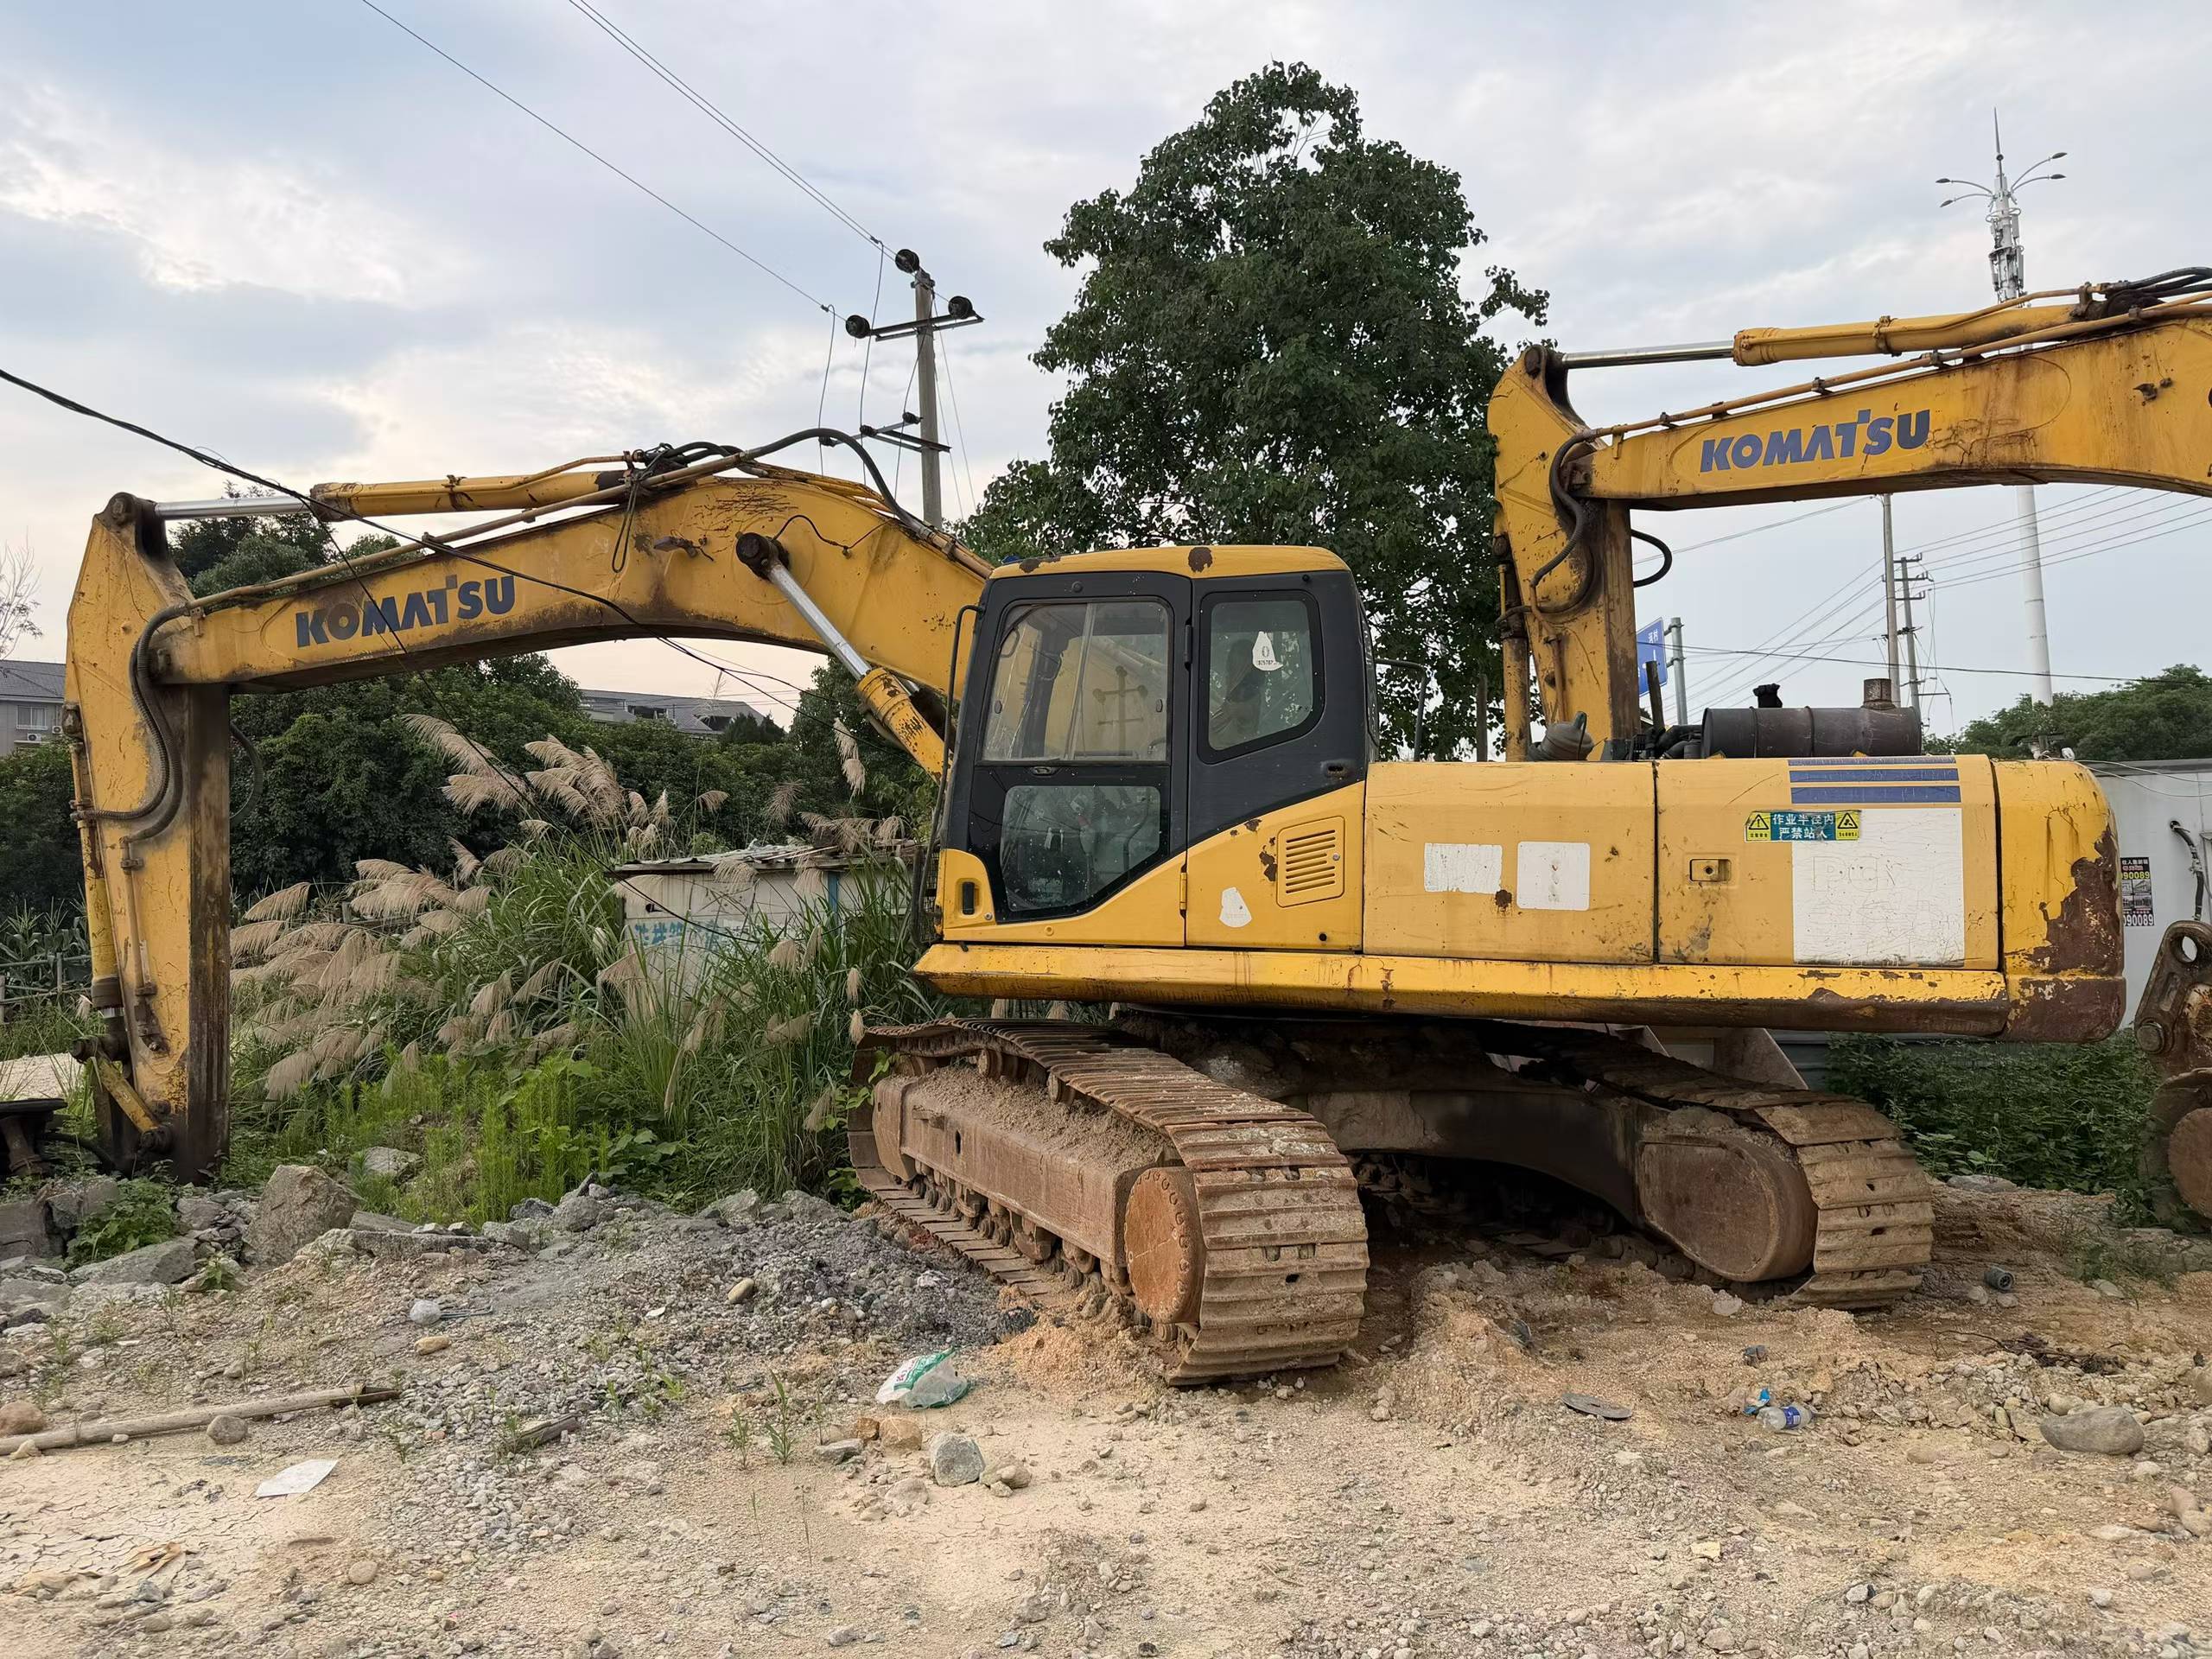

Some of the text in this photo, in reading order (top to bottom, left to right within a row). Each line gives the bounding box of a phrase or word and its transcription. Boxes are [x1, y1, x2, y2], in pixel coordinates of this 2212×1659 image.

[1700, 409, 1930, 473] KOMATSU
[296, 575, 516, 648] KOMATSU
[1773, 813, 1834, 825] 作业半径内
[1779, 827, 1828, 840] 严禁站人
[2121, 871, 2150, 880] 90089
